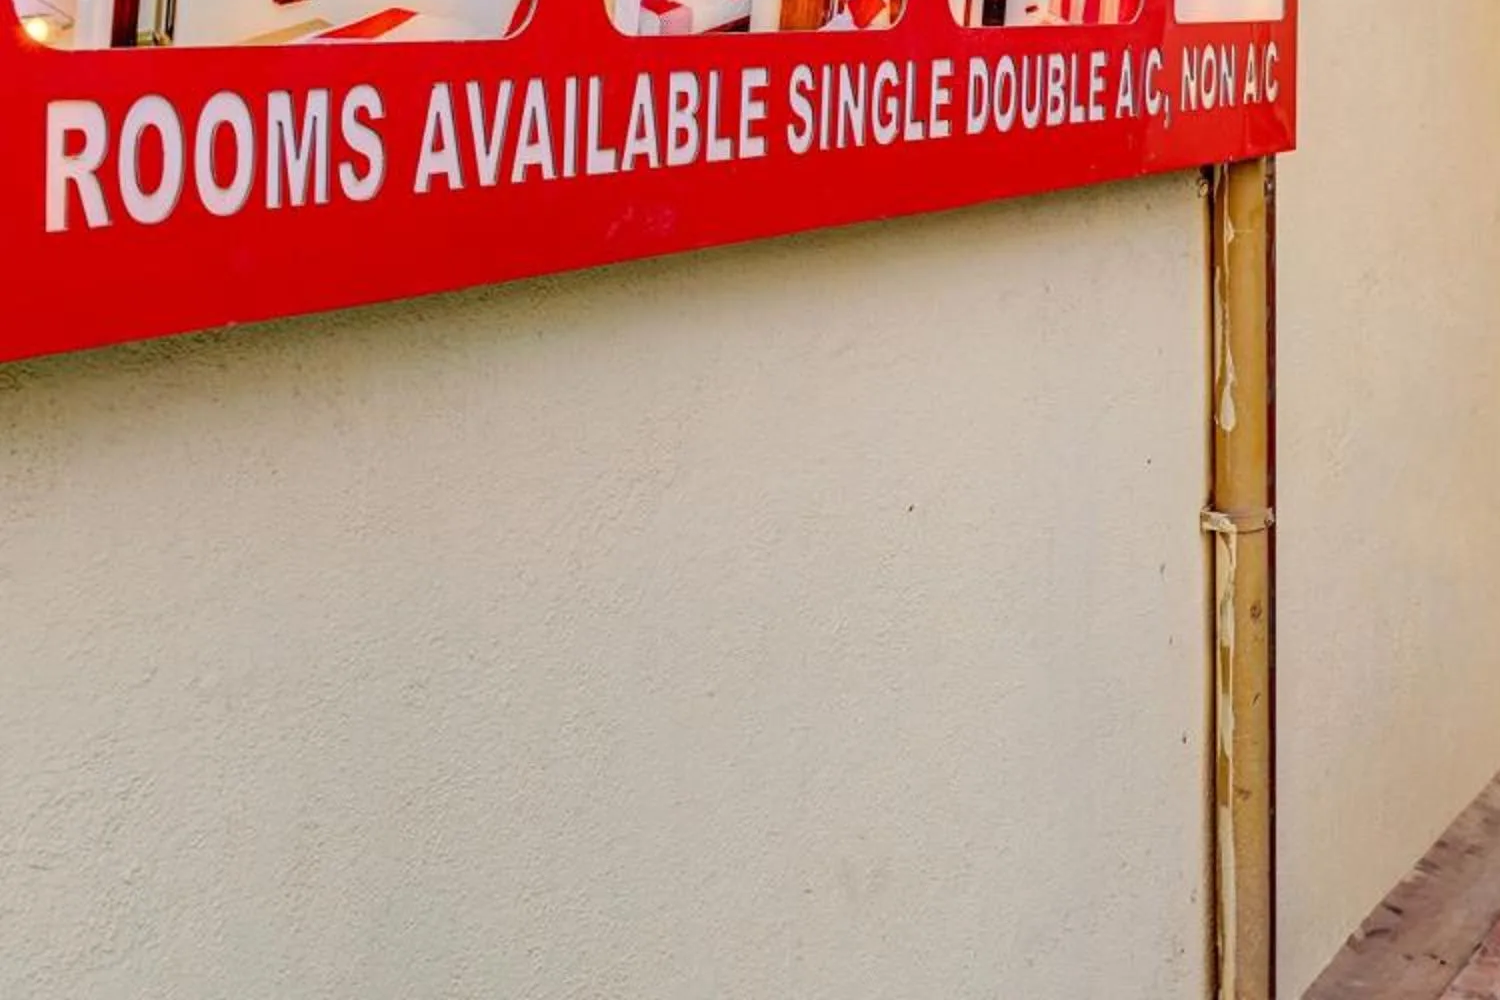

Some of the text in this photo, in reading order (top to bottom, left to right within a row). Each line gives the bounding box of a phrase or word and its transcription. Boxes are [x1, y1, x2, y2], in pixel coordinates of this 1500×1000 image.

[46, 85, 385, 232] ROOMS
[414, 67, 768, 193] AVAILABLE
[787, 58, 952, 153] SINGLE
[967, 49, 1106, 135] DOUBLE
[1181, 43, 1236, 112] NON
